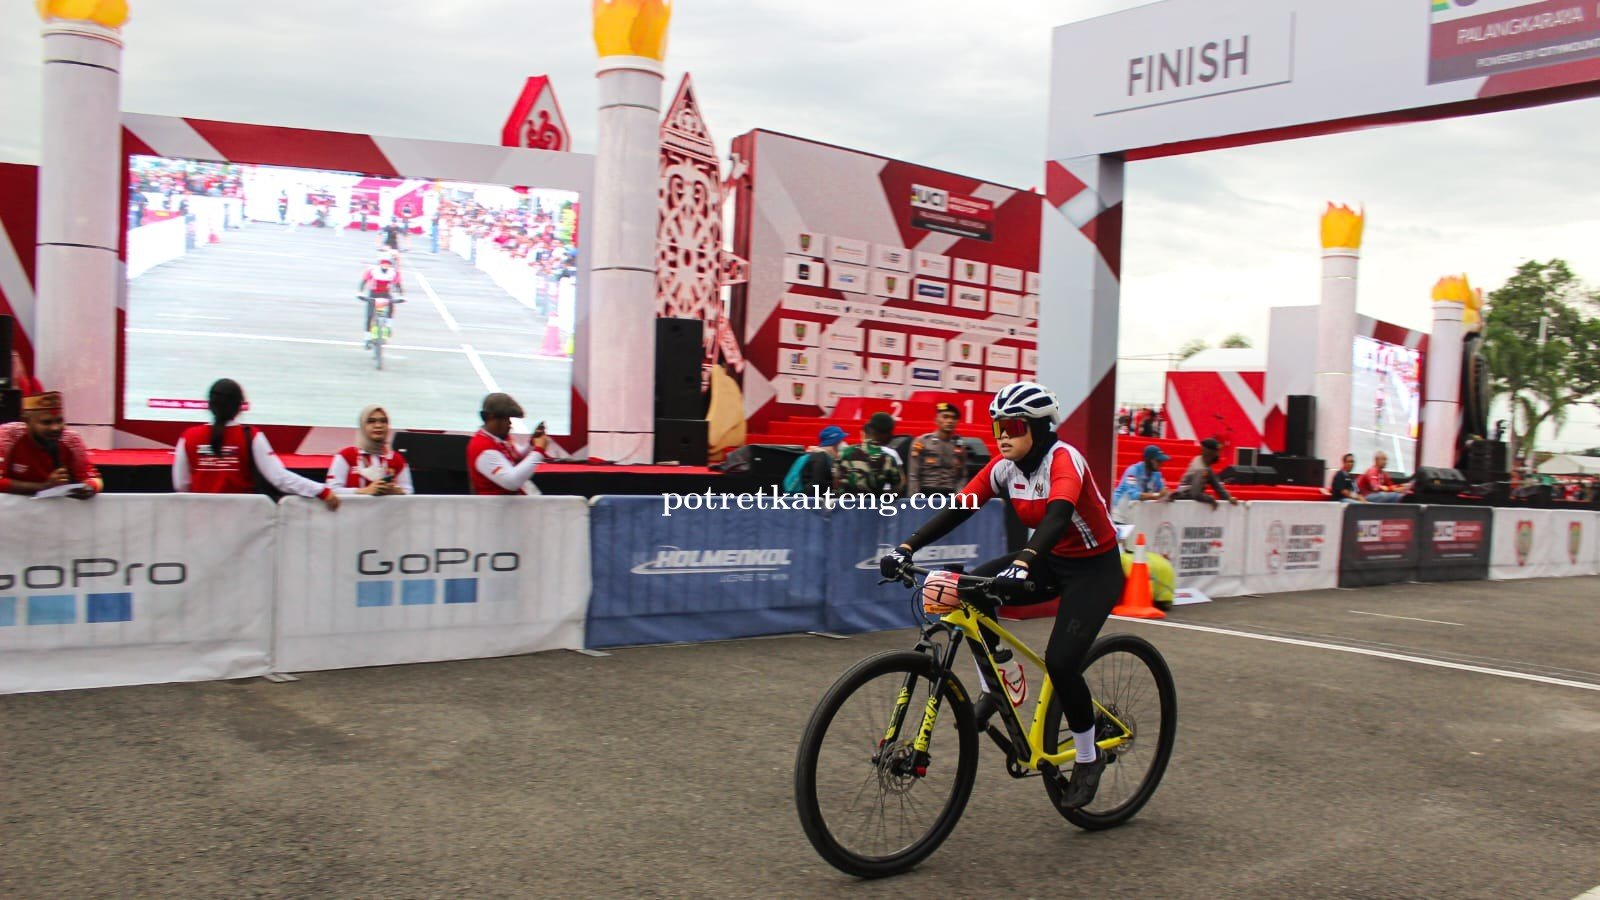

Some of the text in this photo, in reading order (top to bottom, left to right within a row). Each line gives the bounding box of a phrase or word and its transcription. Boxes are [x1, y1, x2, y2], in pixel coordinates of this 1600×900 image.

[1127, 34, 1251, 97] FINISH
[890, 401, 903, 420] 2
[963, 400, 974, 424] 1
[357, 547, 521, 576] GoPro
[654, 549, 793, 569] HOLMENKOL
